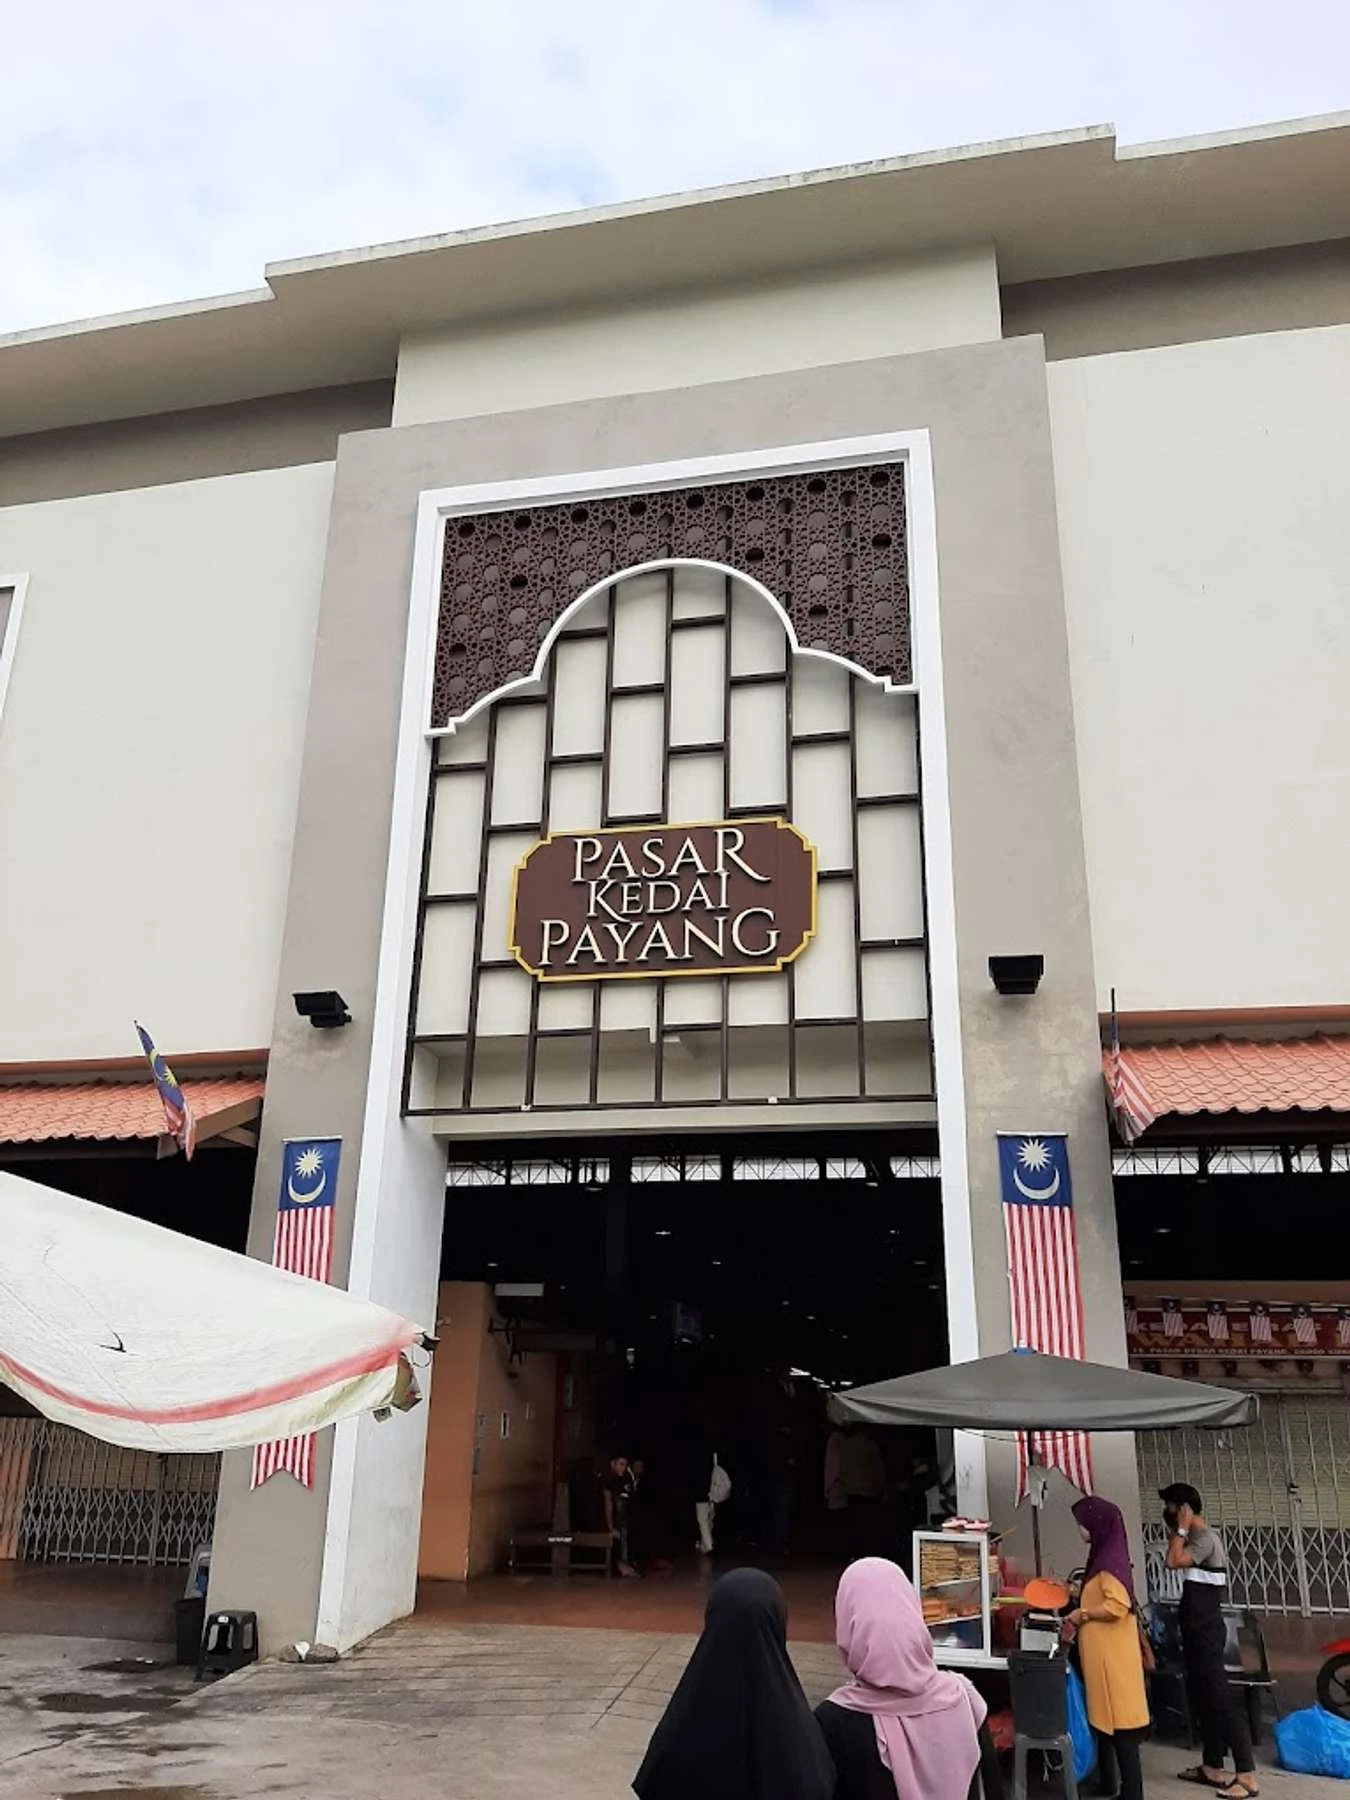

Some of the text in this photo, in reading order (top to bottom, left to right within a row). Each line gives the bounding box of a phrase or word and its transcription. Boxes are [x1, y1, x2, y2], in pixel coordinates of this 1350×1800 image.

[570, 828, 771, 882] PASAR
[586, 871, 730, 922] KEDAI
[538, 907, 781, 966] PAYANG
